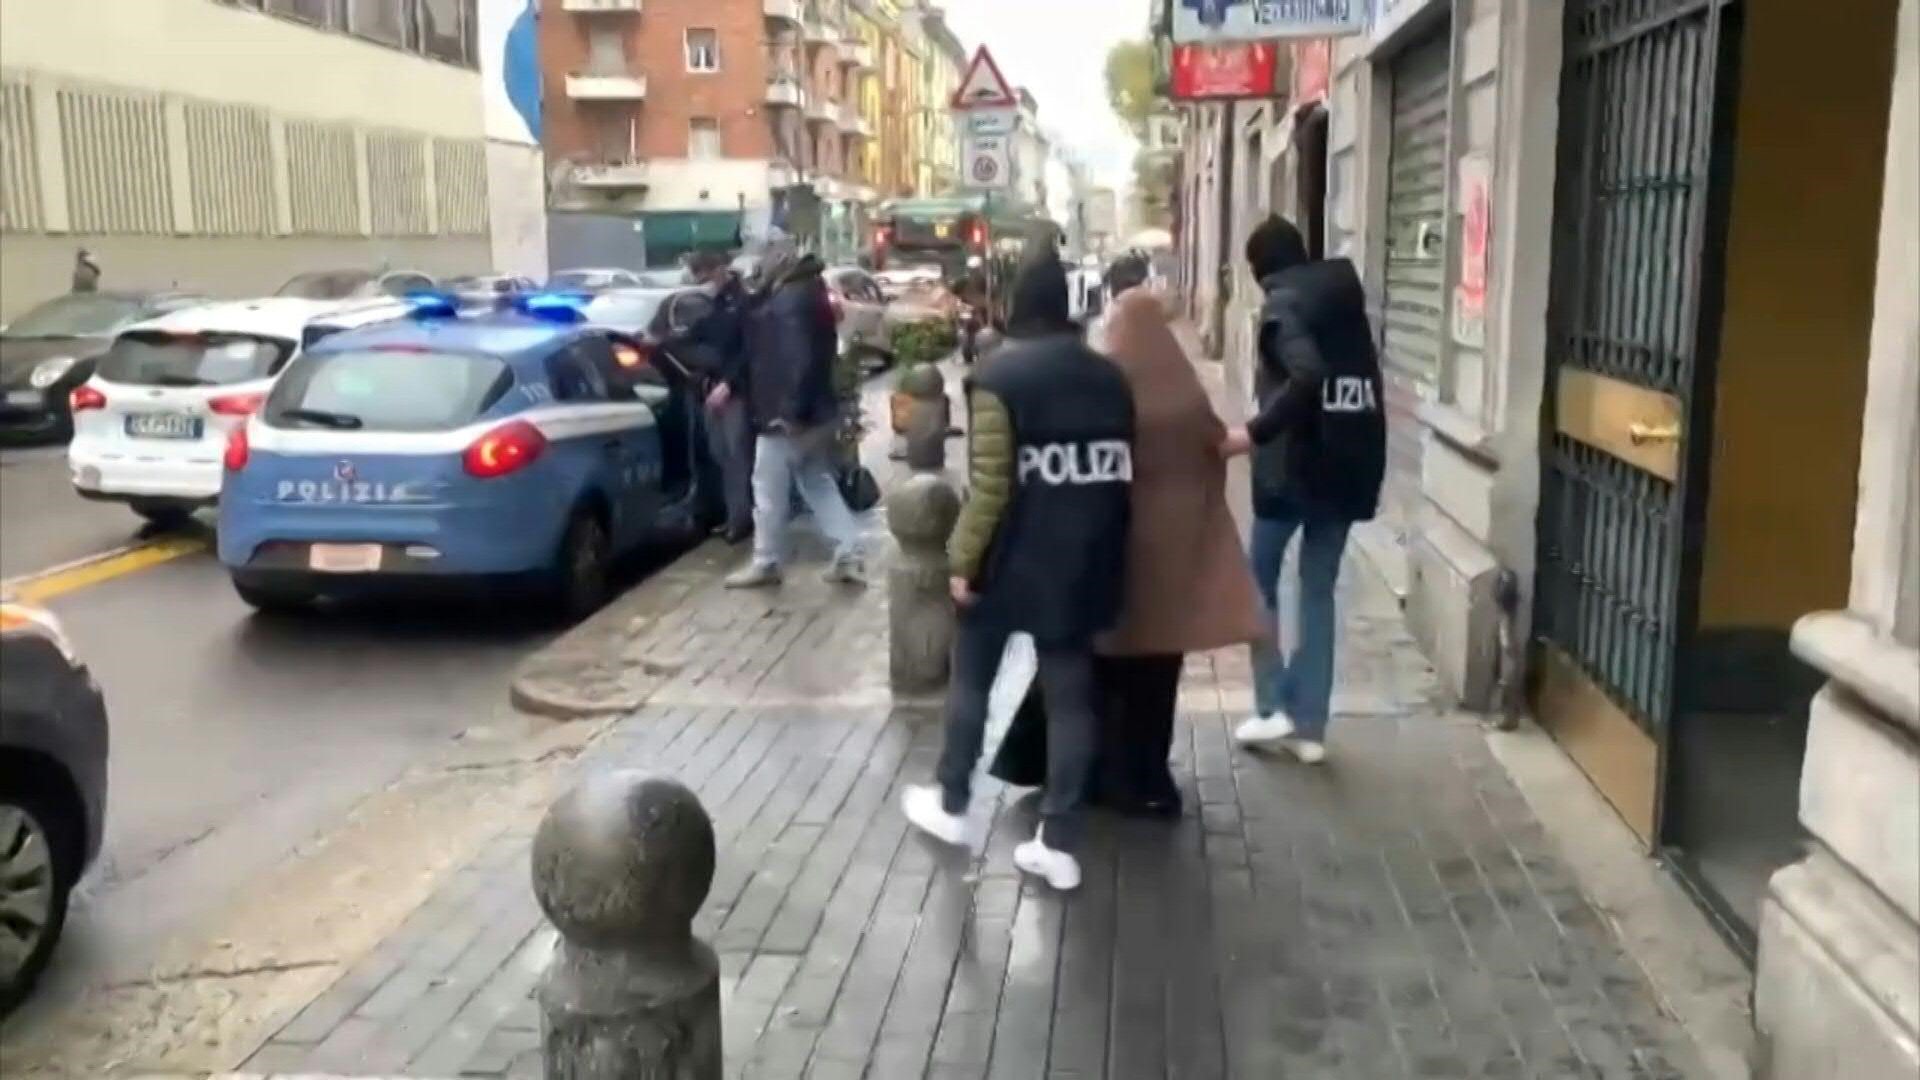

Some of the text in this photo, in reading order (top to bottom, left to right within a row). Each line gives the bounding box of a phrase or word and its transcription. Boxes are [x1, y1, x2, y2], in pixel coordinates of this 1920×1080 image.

[1322, 376, 1376, 411] LIZIA
[1018, 440, 1133, 485] POLIZI
[277, 480, 407, 502] POLIZIA
